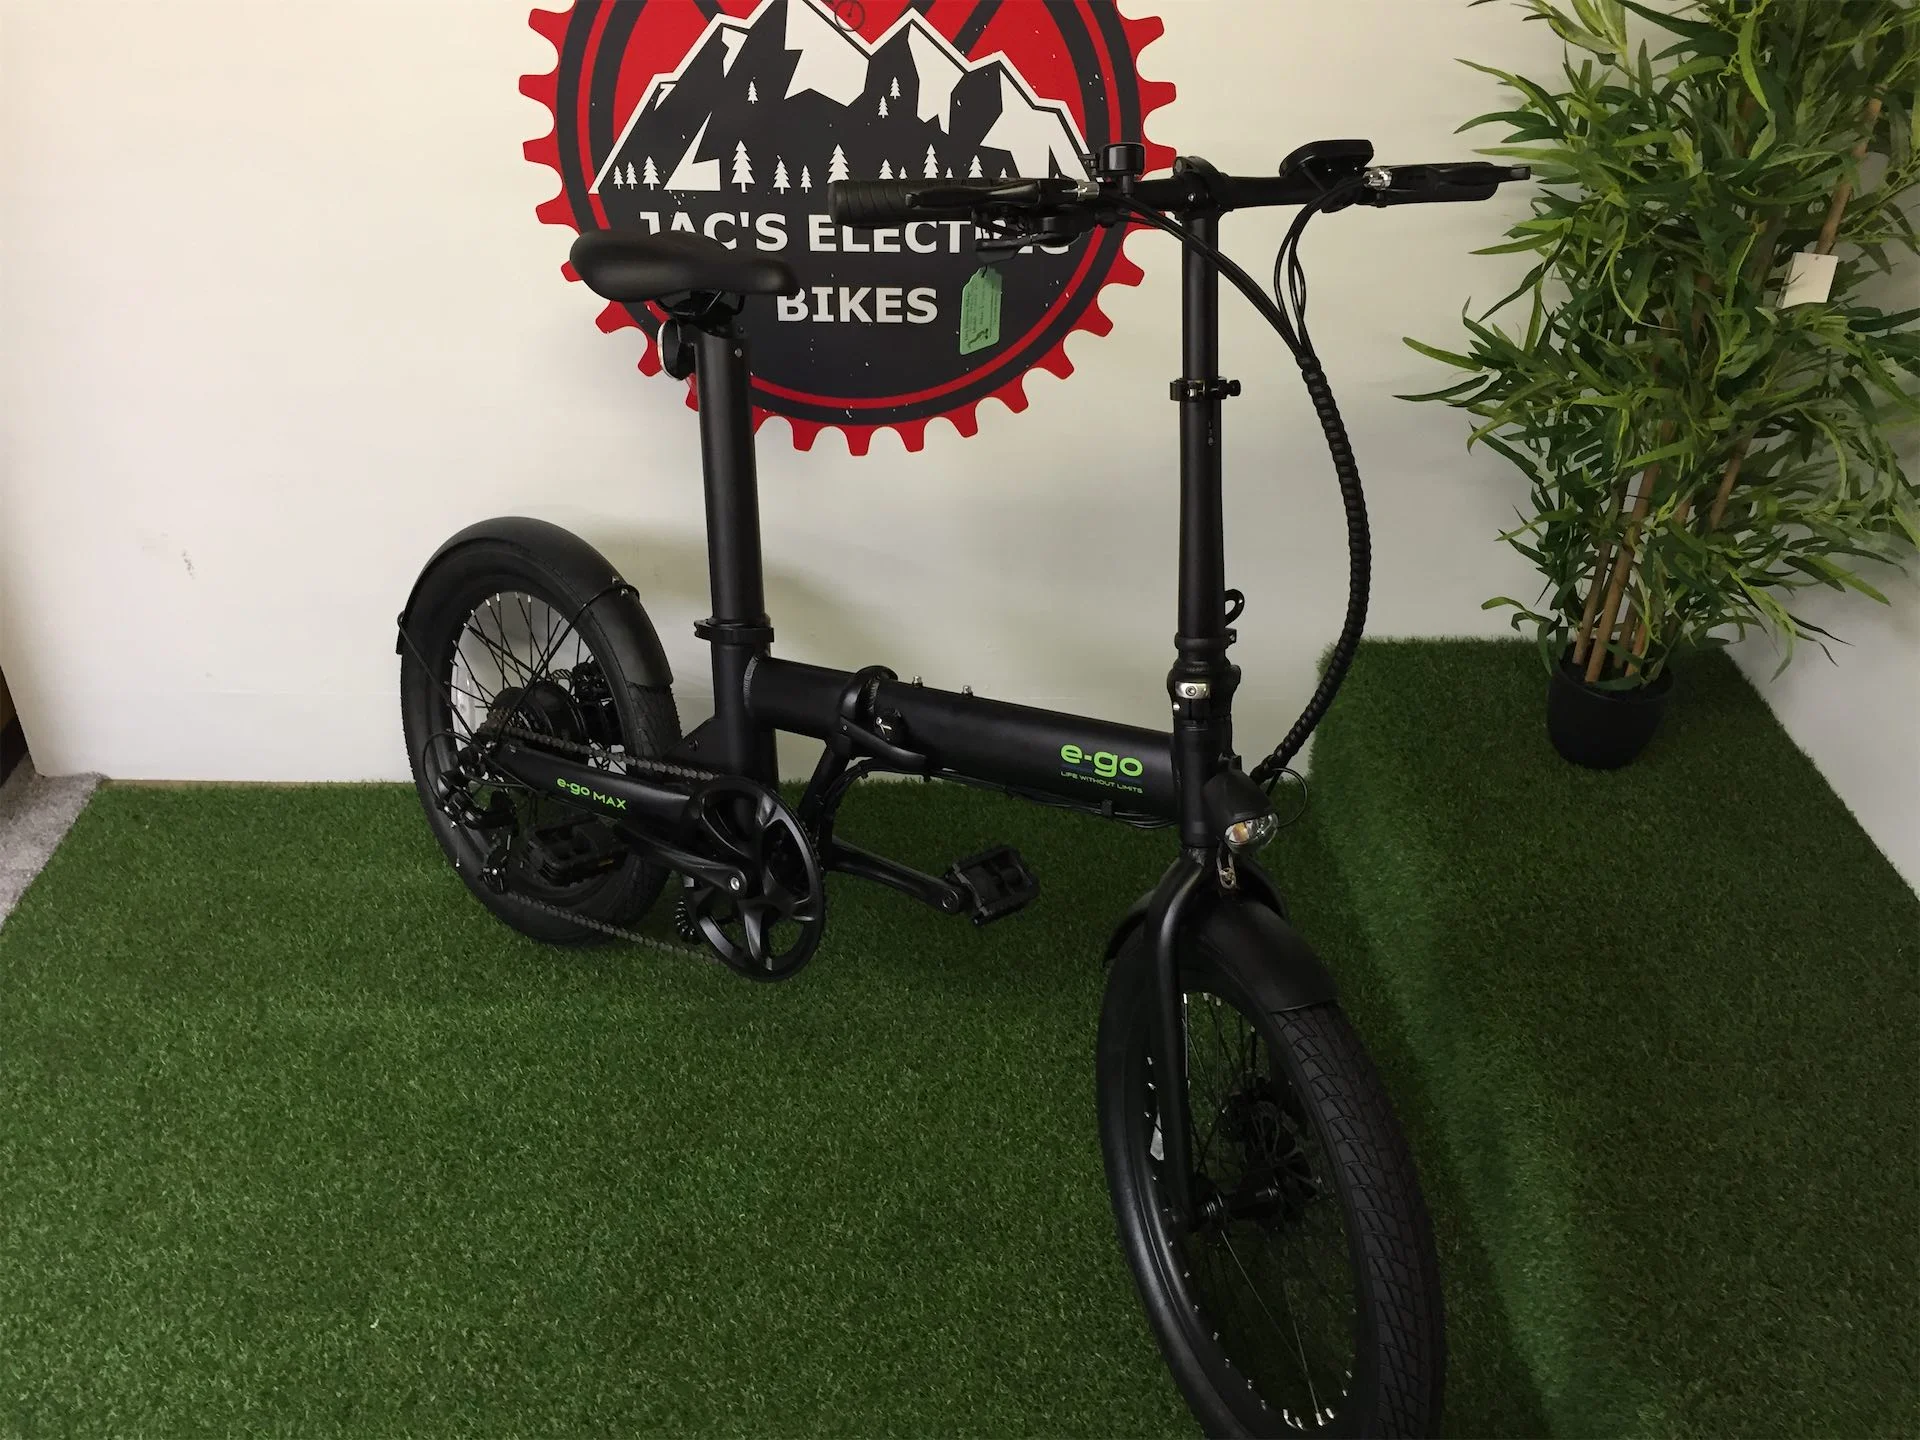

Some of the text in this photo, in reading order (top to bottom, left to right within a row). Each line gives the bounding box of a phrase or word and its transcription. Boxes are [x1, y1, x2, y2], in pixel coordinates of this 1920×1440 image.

[808, 214, 1070, 255] ELECT
[776, 287, 938, 324] BIKES
[1060, 744, 1143, 778] e-go
[556, 778, 627, 810] e-go MAX
[1060, 770, 1143, 794] LIFE WITHOUT LIMITS
